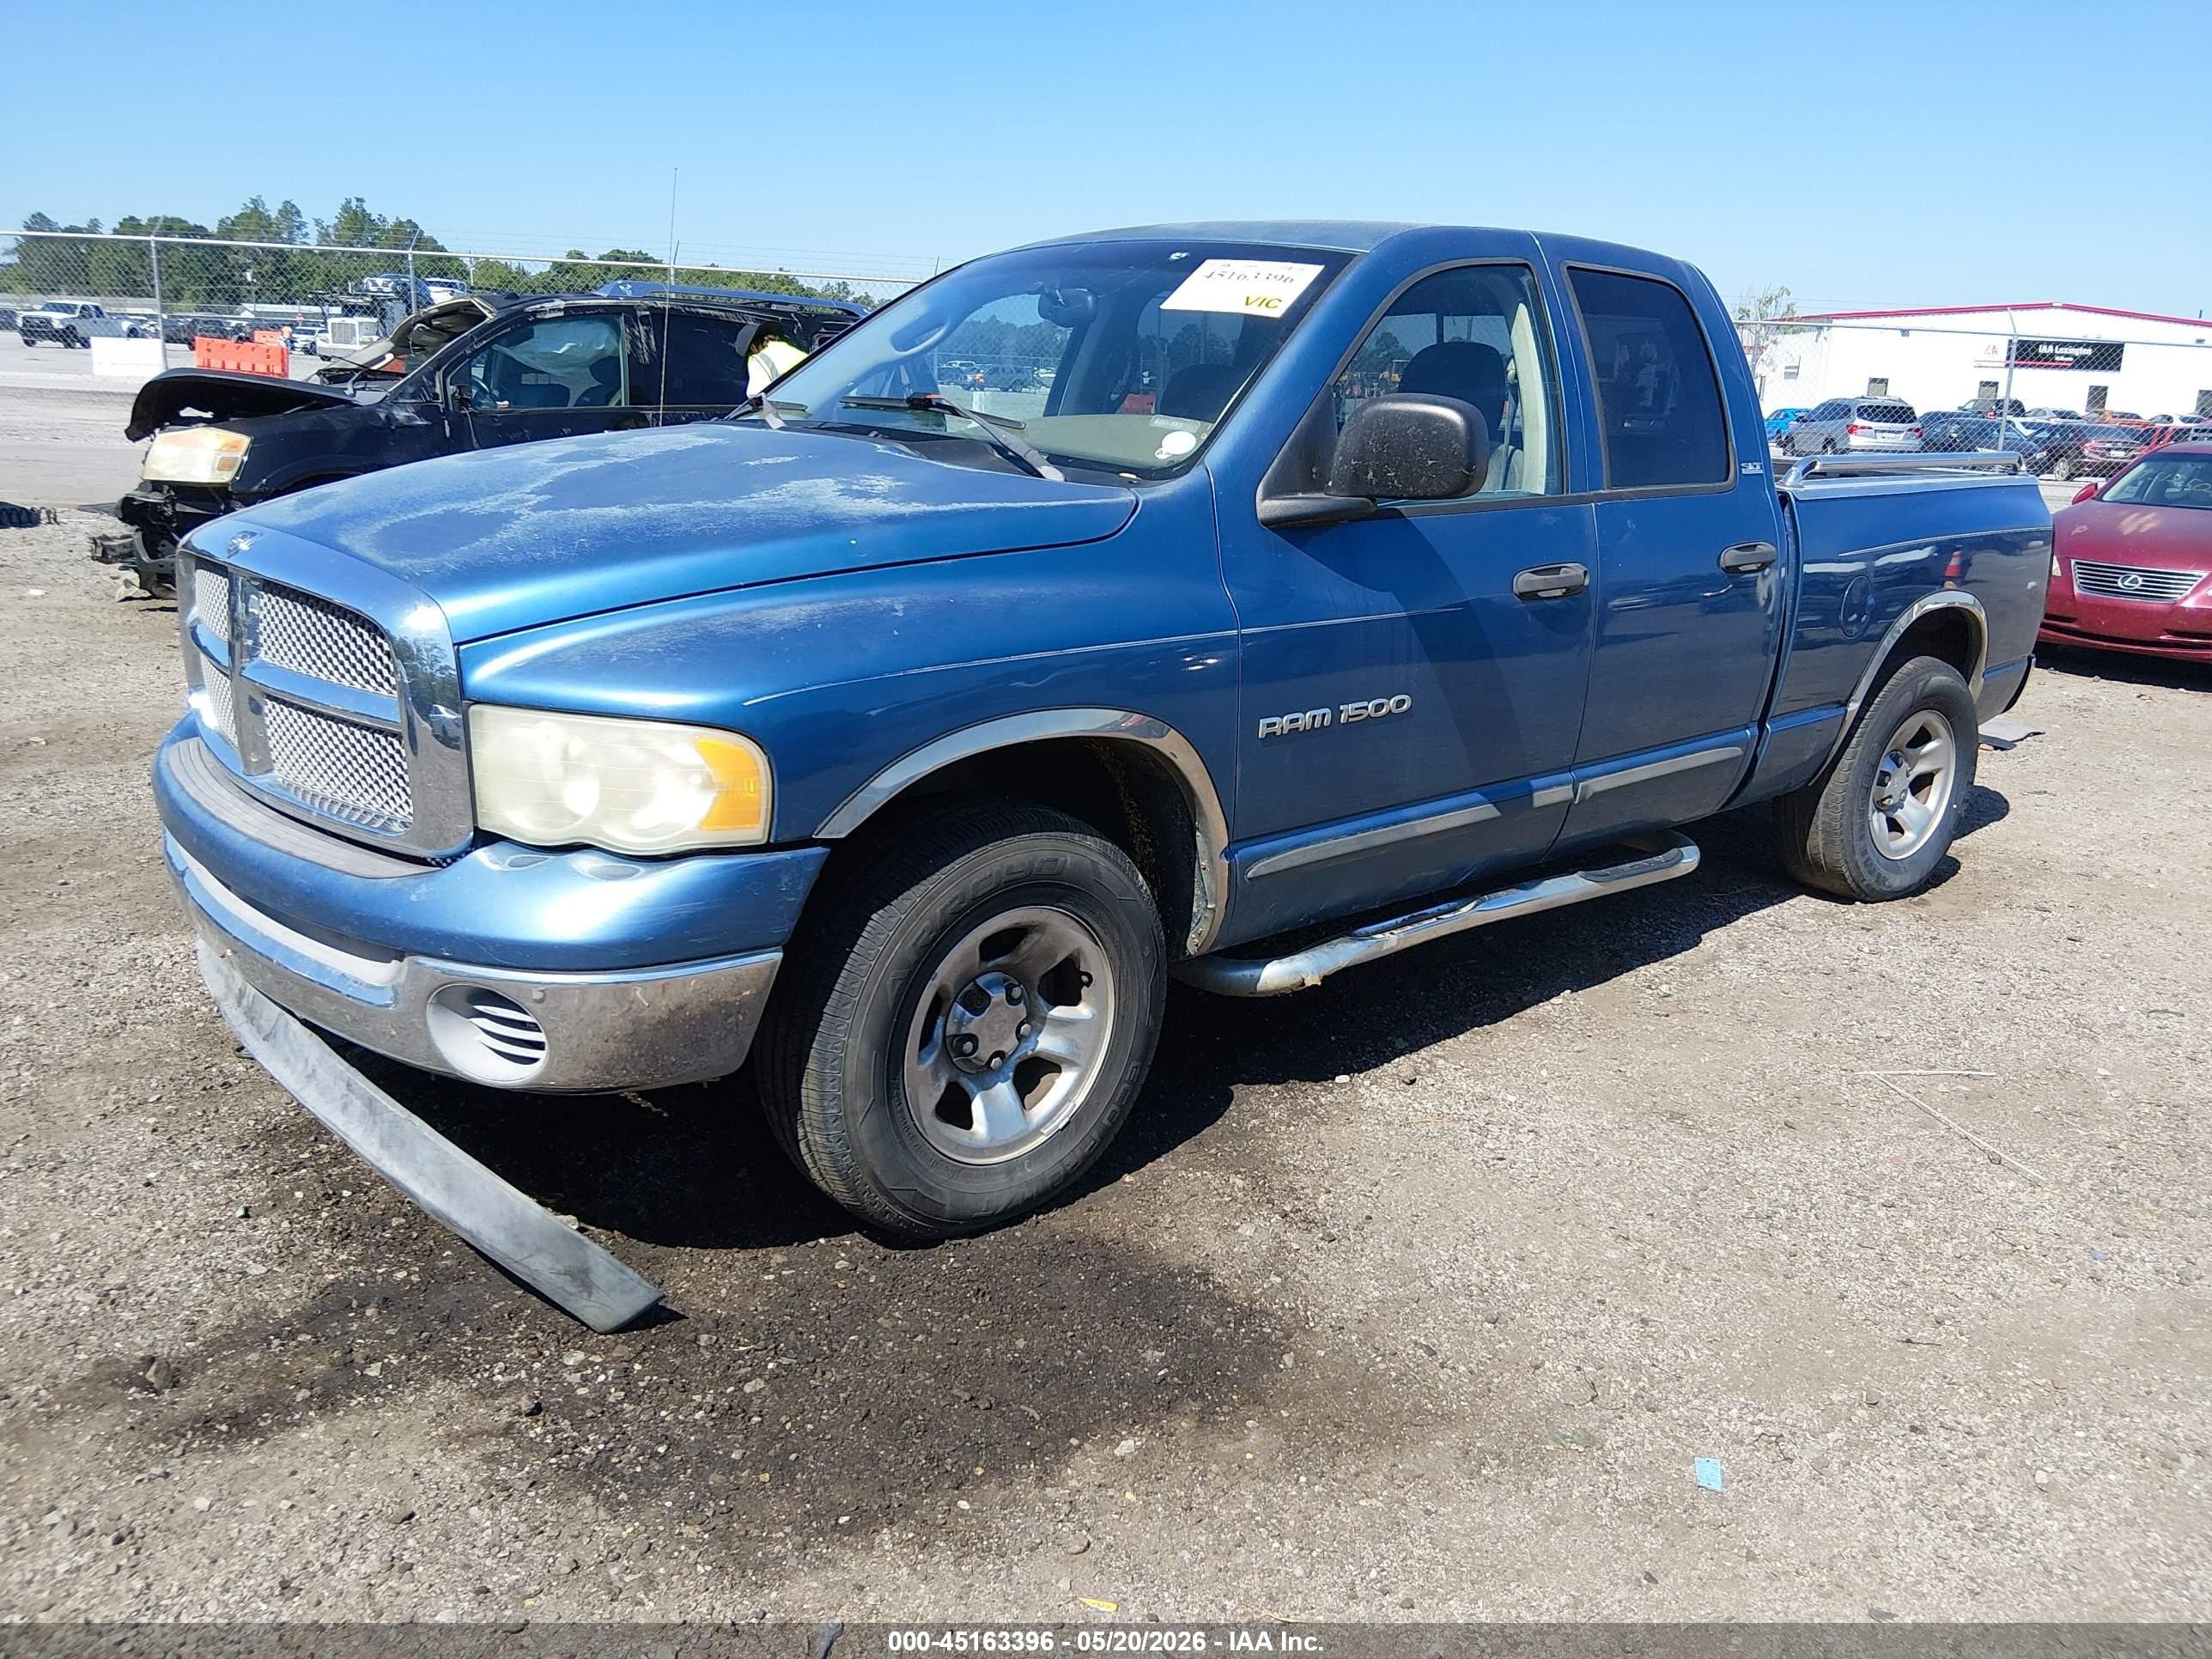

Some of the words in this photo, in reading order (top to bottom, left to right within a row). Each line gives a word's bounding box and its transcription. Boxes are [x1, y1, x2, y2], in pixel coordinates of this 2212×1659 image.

[1244, 295, 1282, 309] VIC
[2039, 344, 2053, 353] IAA
[2055, 345, 2092, 356] Lexington
[1259, 708, 1332, 738] RAM
[1340, 694, 1412, 724] 1500
[882, 856, 1071, 1010] ARROYO
